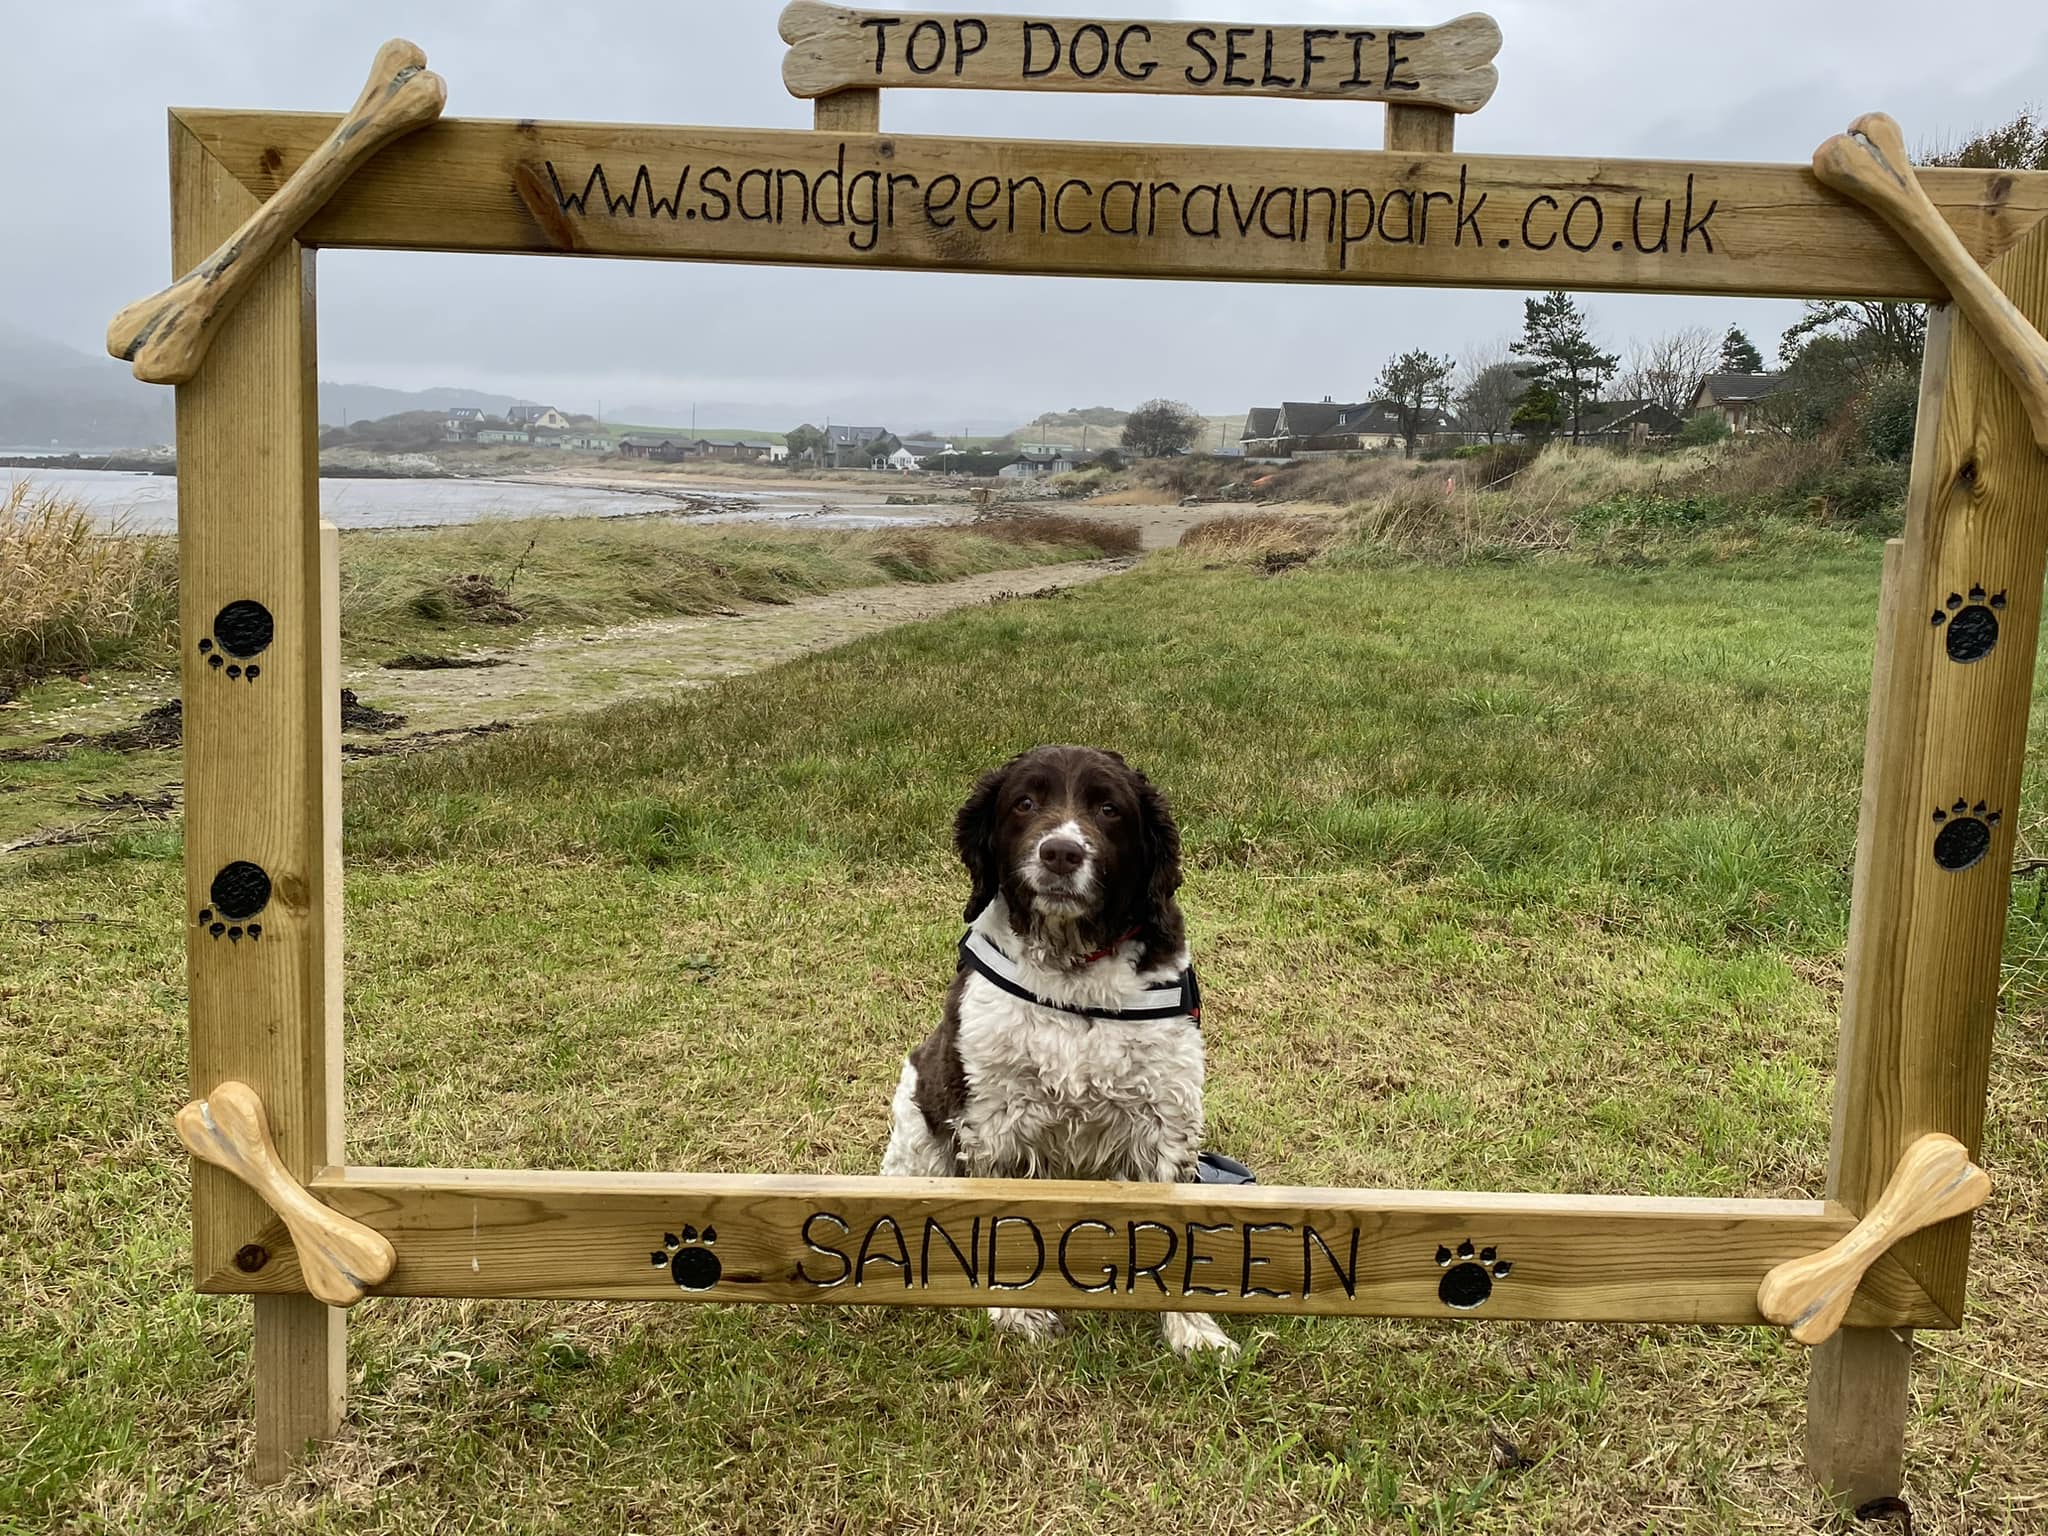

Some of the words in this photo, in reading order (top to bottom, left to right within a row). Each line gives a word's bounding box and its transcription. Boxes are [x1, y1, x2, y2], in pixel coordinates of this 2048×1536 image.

[860, 18, 989, 75] TOP
[1022, 21, 1159, 81] DOG
[1185, 27, 1425, 91] SELFIE
[546, 143, 1718, 270] www.sandgreencaravanpark.co.uk
[796, 1212, 1361, 1301] SANDGREEN
